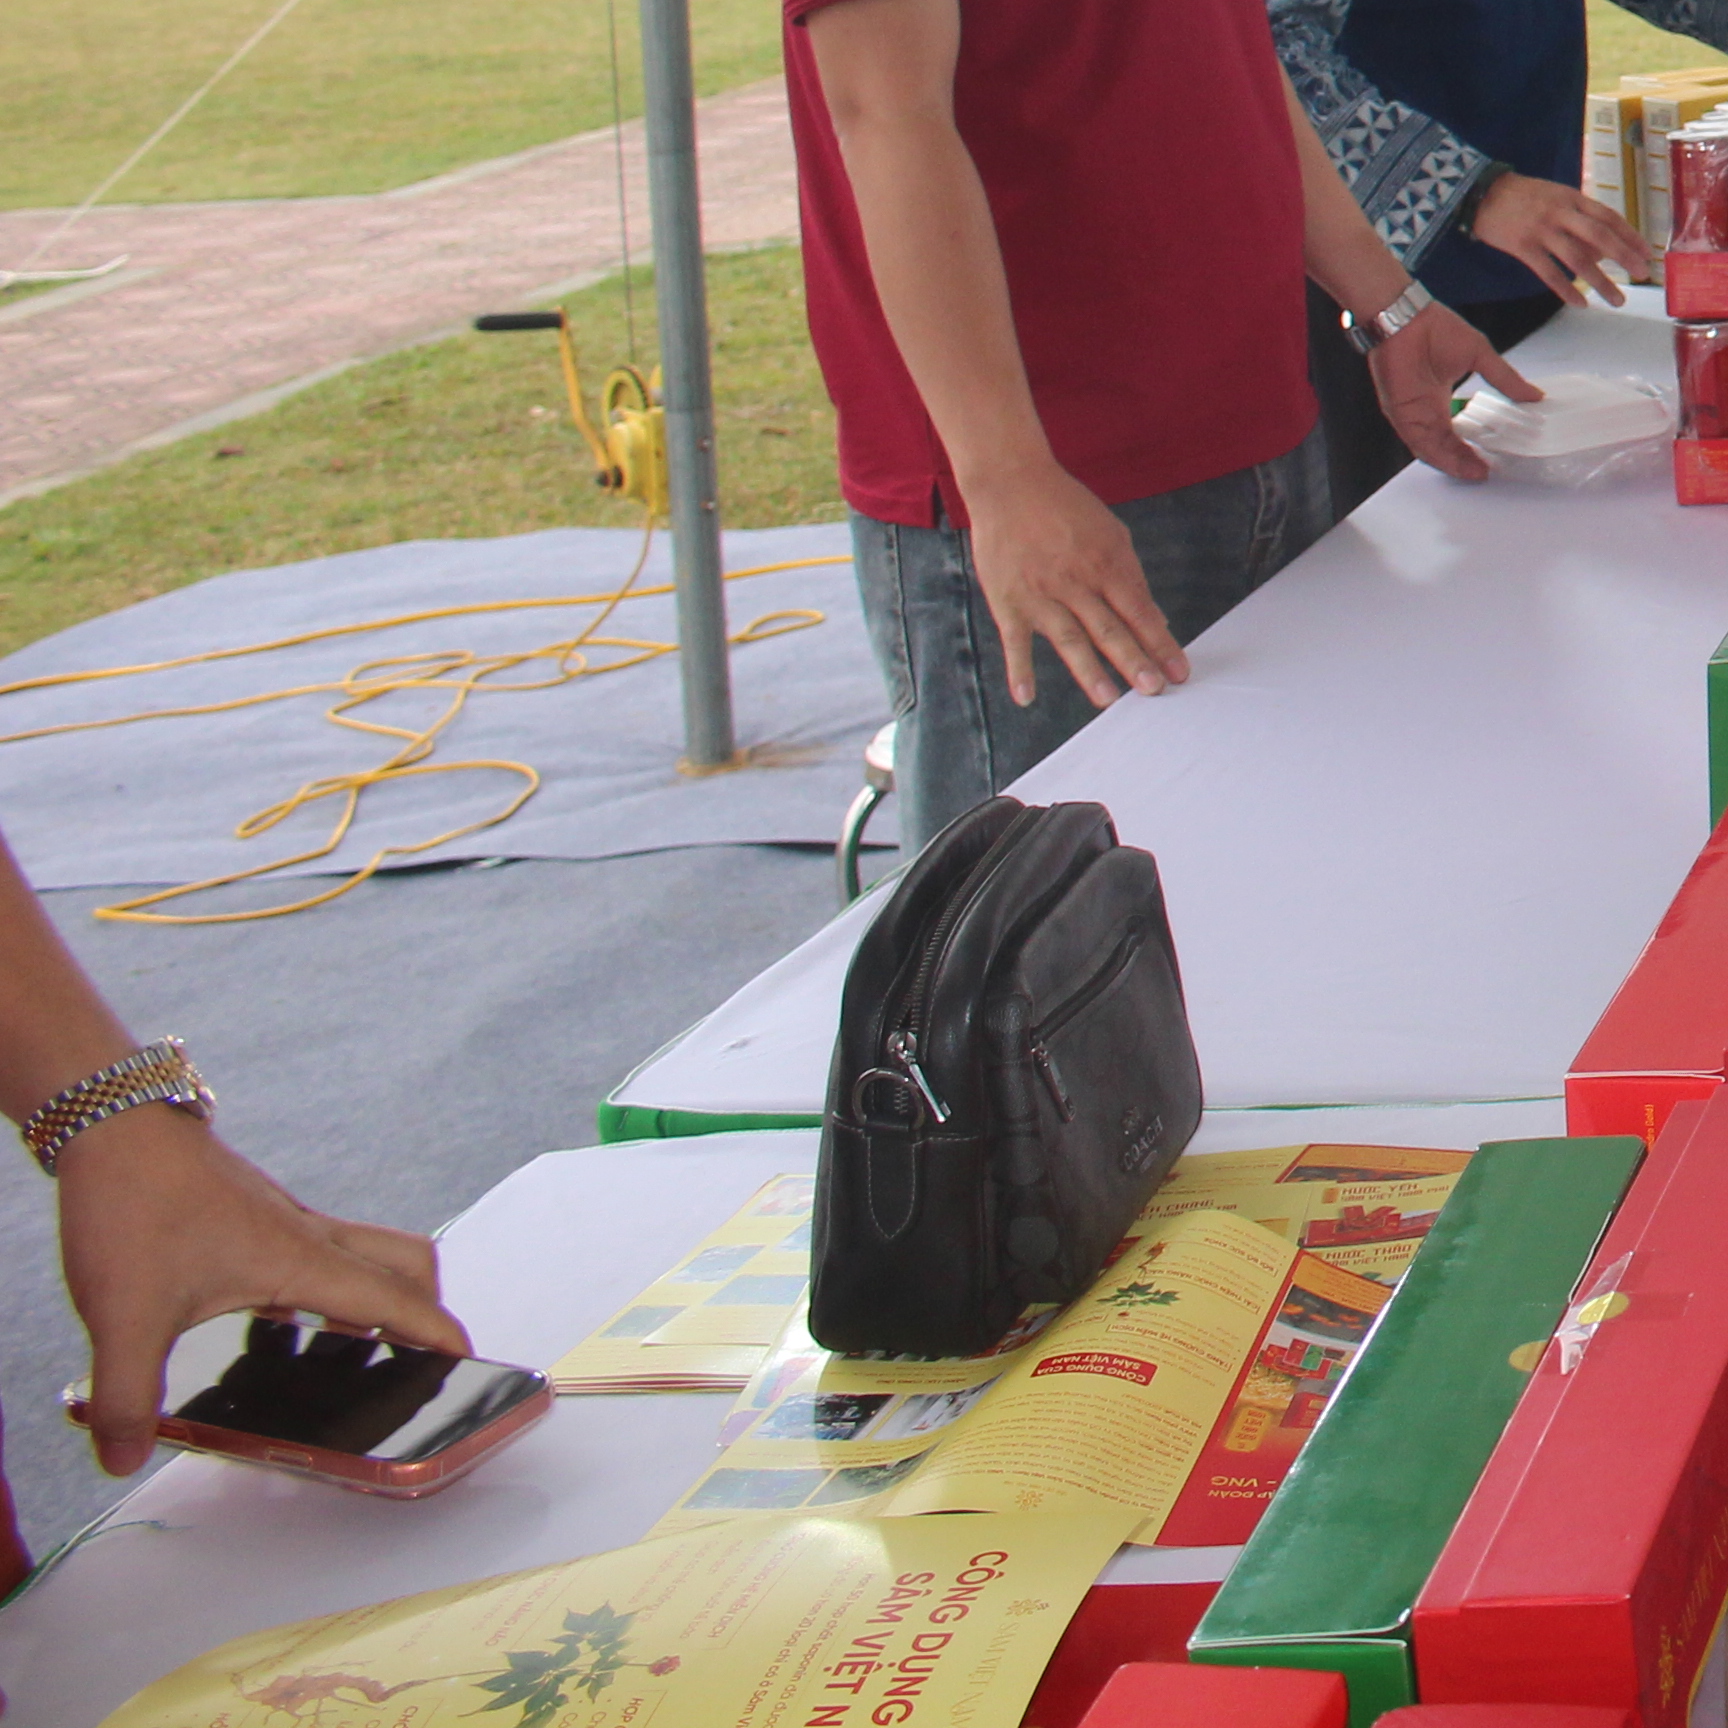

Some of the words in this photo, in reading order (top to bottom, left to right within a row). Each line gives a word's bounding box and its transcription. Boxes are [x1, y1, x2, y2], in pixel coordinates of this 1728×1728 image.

[1123, 1115, 1163, 1171] COACH
[1050, 1355, 1079, 1363] NAM
[1066, 1360, 1104, 1371] DỤNG
[1111, 1357, 1141, 1369] SÂM
[1104, 1365, 1145, 1383] CÔNG
[1210, 1475, 1258, 1487] VNG
[1207, 1489, 1253, 1498] ĐOÀN
[845, 1590, 863, 1601] 50
[928, 1552, 1011, 1625] CÔNG
[865, 1573, 935, 1623] SÂM
[797, 1617, 815, 1627] 20
[816, 1620, 838, 1641] chất
[790, 1643, 821, 1681] saponin
[823, 1631, 894, 1694] VIỆT
[871, 1632, 954, 1726] DỤNG
[779, 1685, 798, 1698] đã
[742, 1690, 767, 1713] Sâm
